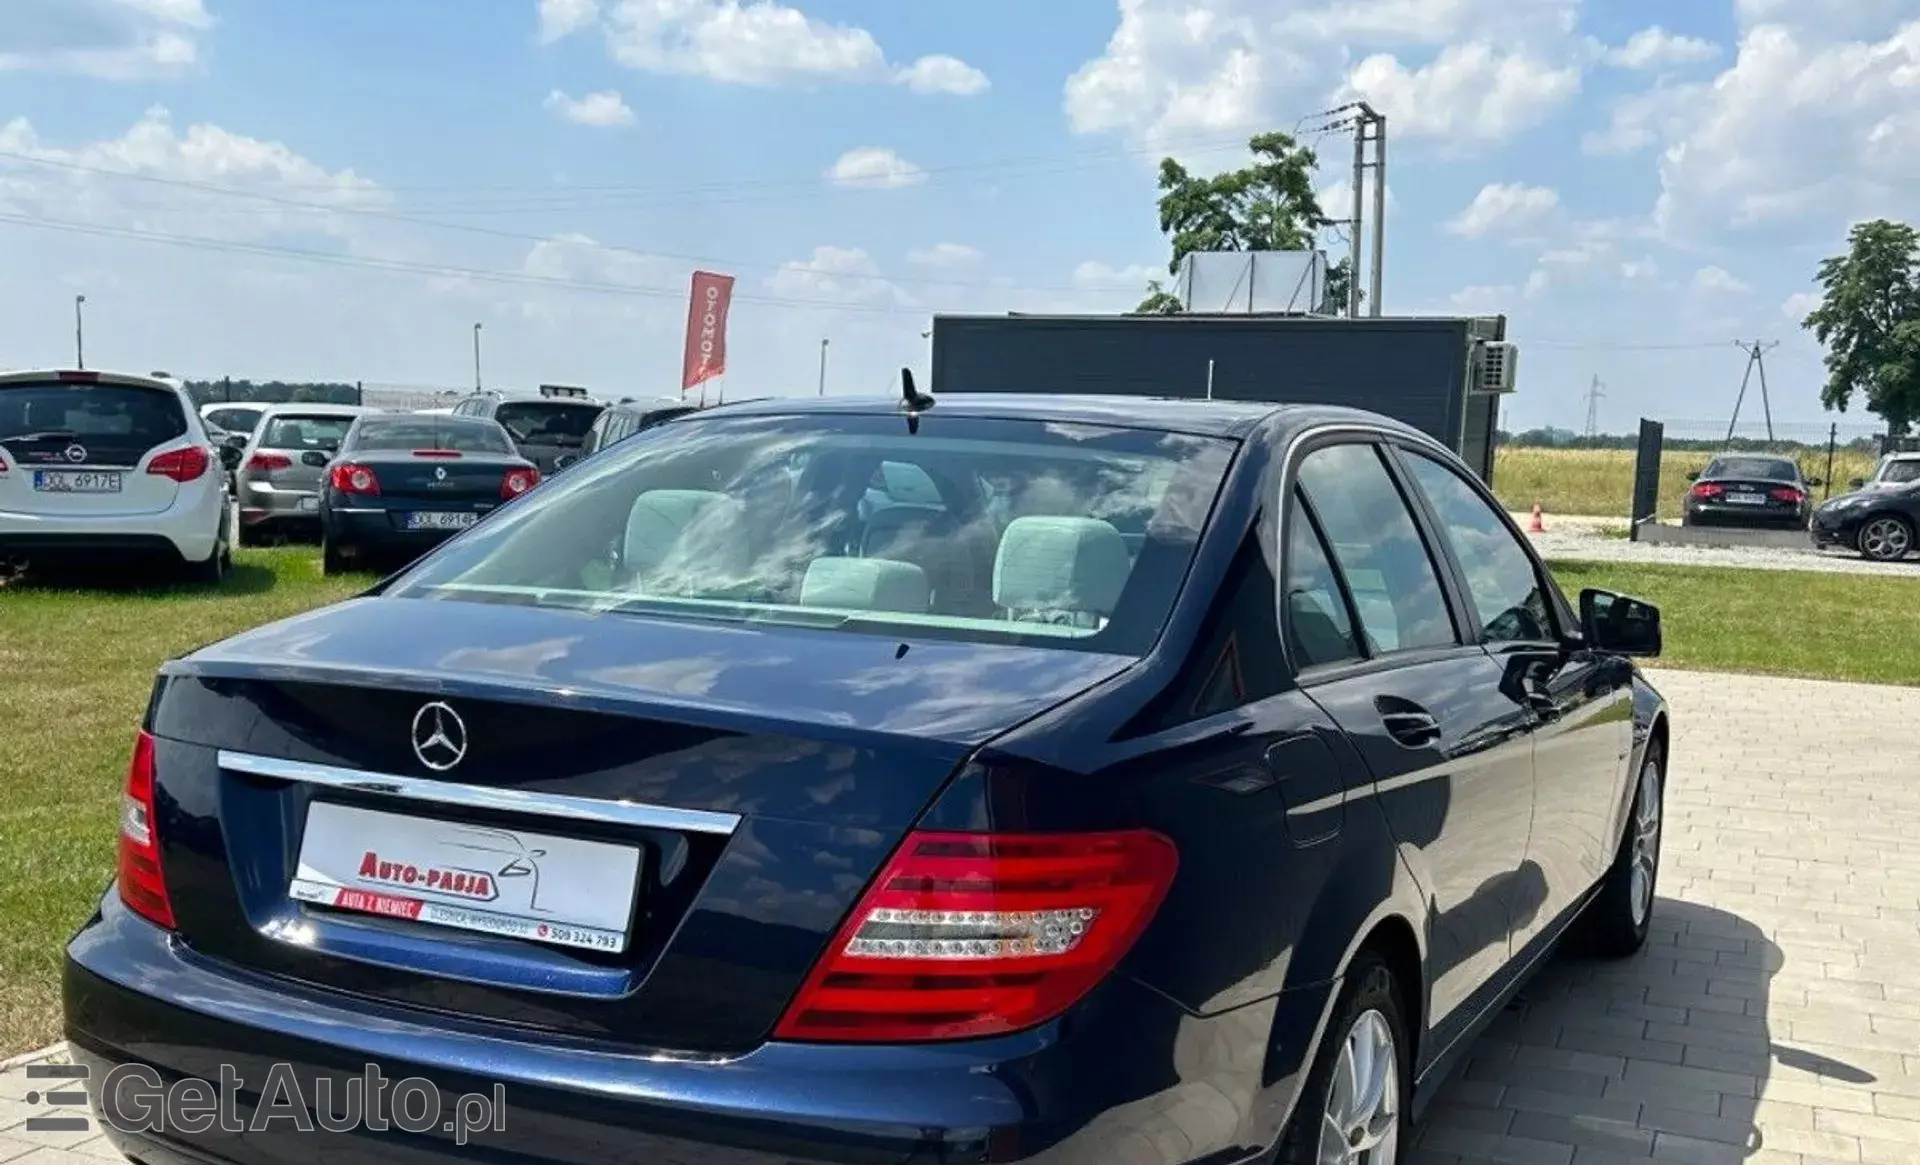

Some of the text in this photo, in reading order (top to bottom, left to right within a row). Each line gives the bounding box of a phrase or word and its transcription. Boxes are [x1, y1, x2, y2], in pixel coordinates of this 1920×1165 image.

[358, 851, 489, 895] AUTO-PASJA
[551, 926, 617, 949] 509 324 793
